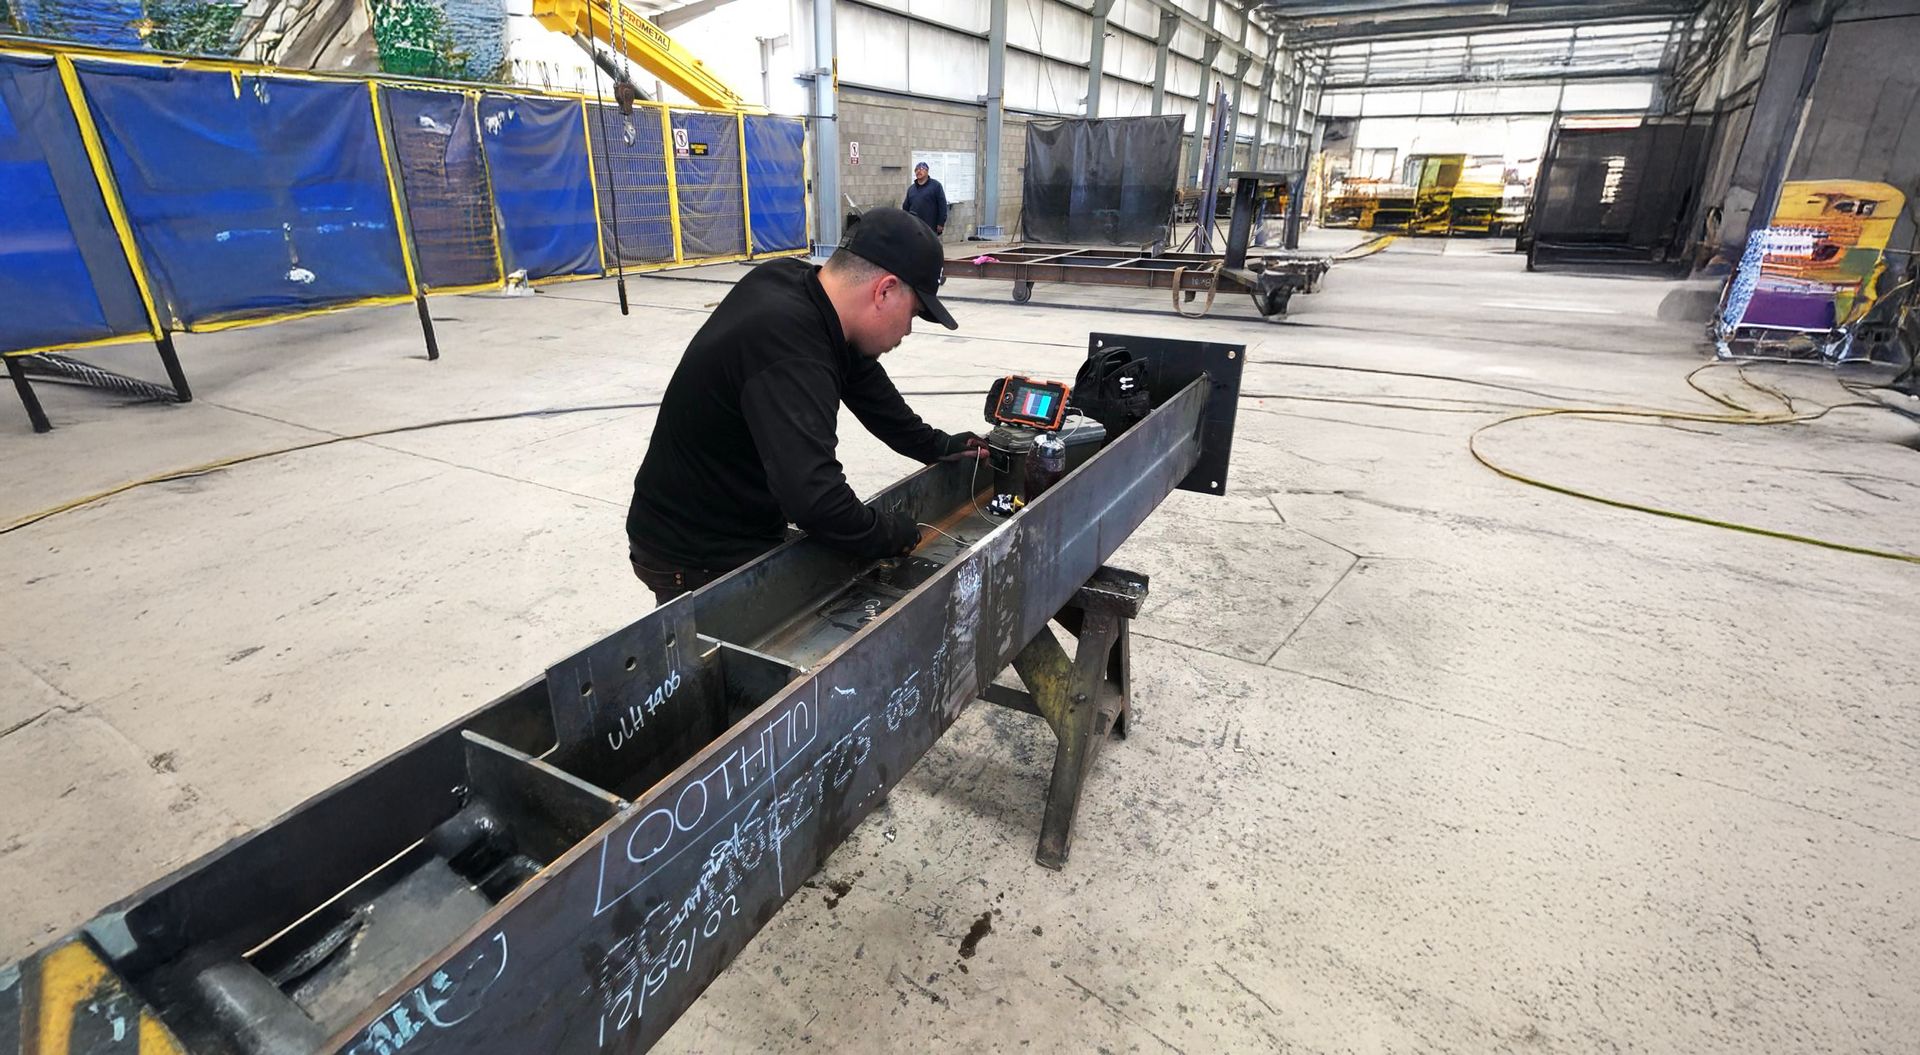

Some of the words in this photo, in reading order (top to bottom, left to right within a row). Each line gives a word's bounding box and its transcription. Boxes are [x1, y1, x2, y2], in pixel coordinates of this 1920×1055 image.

[622, 9, 667, 47] PROMETAL
[627, 701, 808, 863] ULH100
[599, 895, 740, 1048] 20/05/21
